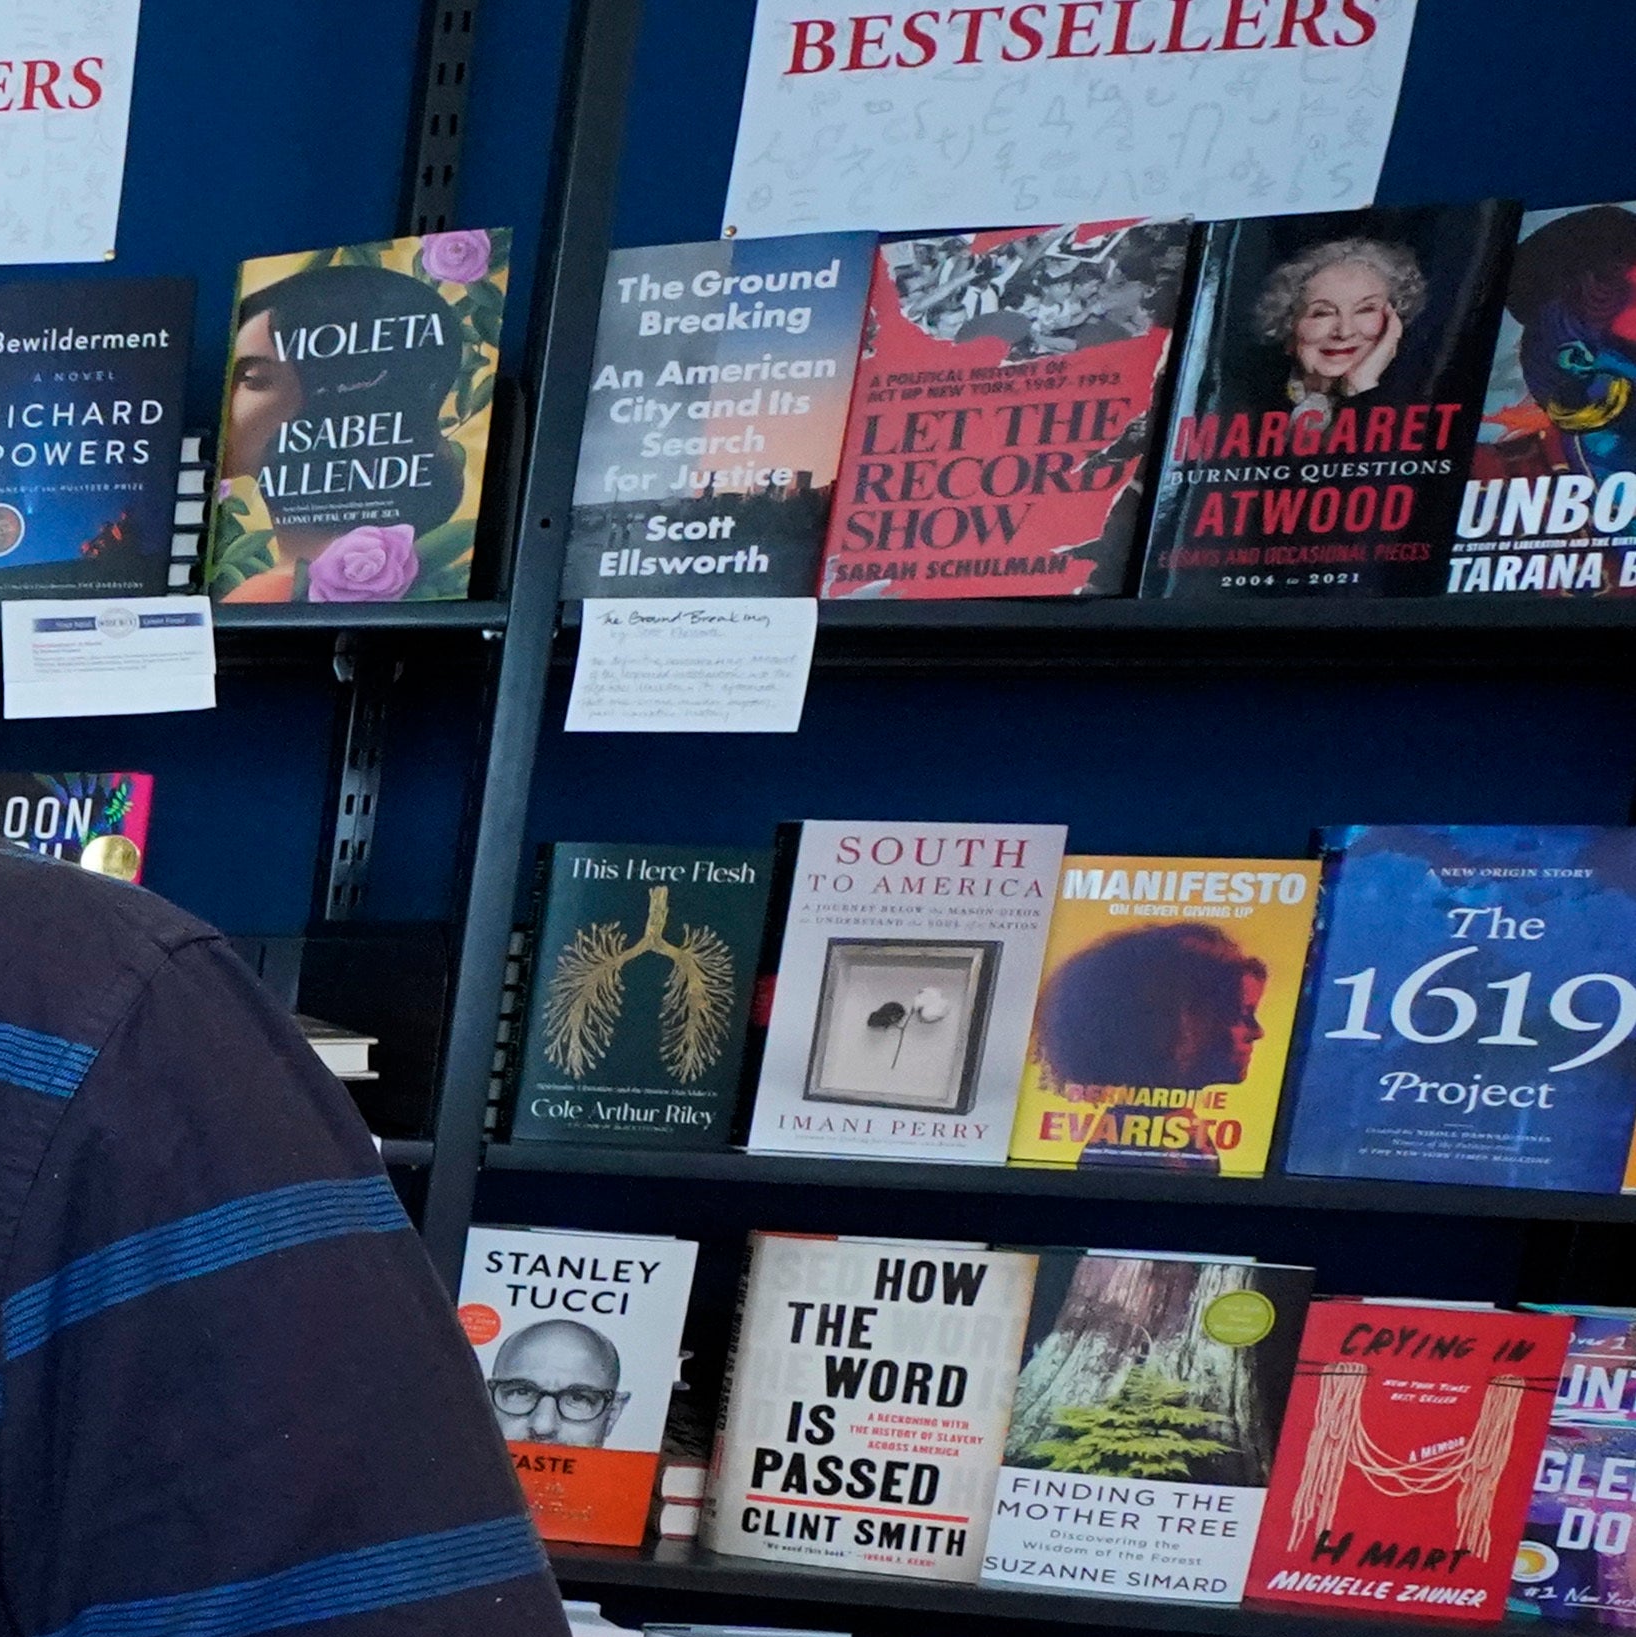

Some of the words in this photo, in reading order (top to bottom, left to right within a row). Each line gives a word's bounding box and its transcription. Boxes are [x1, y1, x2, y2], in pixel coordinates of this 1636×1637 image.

[783, 0, 1381, 75] BESTSELLERS
[618, 274, 685, 305] The
[692, 260, 840, 297] Ground
[272, 313, 445, 362] VIOLETA
[639, 305, 812, 337] Breaking
[54, 370, 115, 383] NOVEL
[658, 355, 837, 386] American
[278, 411, 413, 453] ISABEL
[995, 397, 1132, 449] THE
[1173, 402, 1462, 462] MARGARET
[252, 453, 435, 498] ALLENDE
[671, 461, 794, 490] Justice
[852, 450, 1132, 505] RECORD
[1168, 465, 1291, 485] BURNING
[1300, 458, 1452, 482] QUESTIONS
[645, 514, 736, 542] Scott
[842, 502, 1030, 553] SHOW
[1194, 484, 1414, 537] ATWOOD
[599, 549, 770, 577] Ellsworth
[927, 555, 1067, 580] SCHULMAN
[1221, 573, 1276, 586] 2004
[1309, 571, 1360, 585] 2021
[1447, 554, 1603, 594] TARANA
[836, 836, 1030, 870] SOUTH
[692, 860, 757, 885] Flesh
[874, 874, 1045, 899] AMERICA
[1062, 869, 1307, 905] MANIFESTO
[1479, 868, 1537, 878] ORIGIN
[1543, 868, 1594, 879] STORY
[1133, 904, 1178, 917] NEVER
[1182, 905, 1230, 918] GIVING
[1448, 906, 1545, 941] The
[1325, 945, 1636, 1073] 1619
[1065, 1082, 1228, 1111] BERNARDINE
[1379, 1071, 1556, 1114] Project
[530, 1098, 584, 1123] Cole
[666, 1105, 719, 1130] Riley
[778, 1113, 874, 1136] IMANI
[891, 1119, 991, 1141] PERRY
[1039, 1111, 1243, 1151] EVARISTO
[485, 1249, 661, 1285] STANLEY
[873, 1257, 988, 1307] HOW
[505, 1283, 629, 1315] TUCCI
[1340, 1321, 1478, 1362] CRYING
[824, 1355, 967, 1408] WORD
[750, 1447, 939, 1506] PASSED
[1011, 1476, 1155, 1508] FINDING
[741, 1506, 842, 1544] CLINT
[853, 1519, 967, 1557] SMITH
[996, 1498, 1149, 1532] MOTHER
[1157, 1515, 1239, 1538] TREE
[1023, 1540, 1088, 1555] Wisdom
[1151, 1552, 1202, 1566] Forest
[1311, 1530, 1351, 1565] H
[1358, 1533, 1473, 1575] MART
[983, 1555, 1116, 1587] SUZANNE
[1126, 1570, 1227, 1595] SIMARD
[1267, 1570, 1394, 1602] MICHELLE
[1397, 1583, 1489, 1610] ZAUNER
